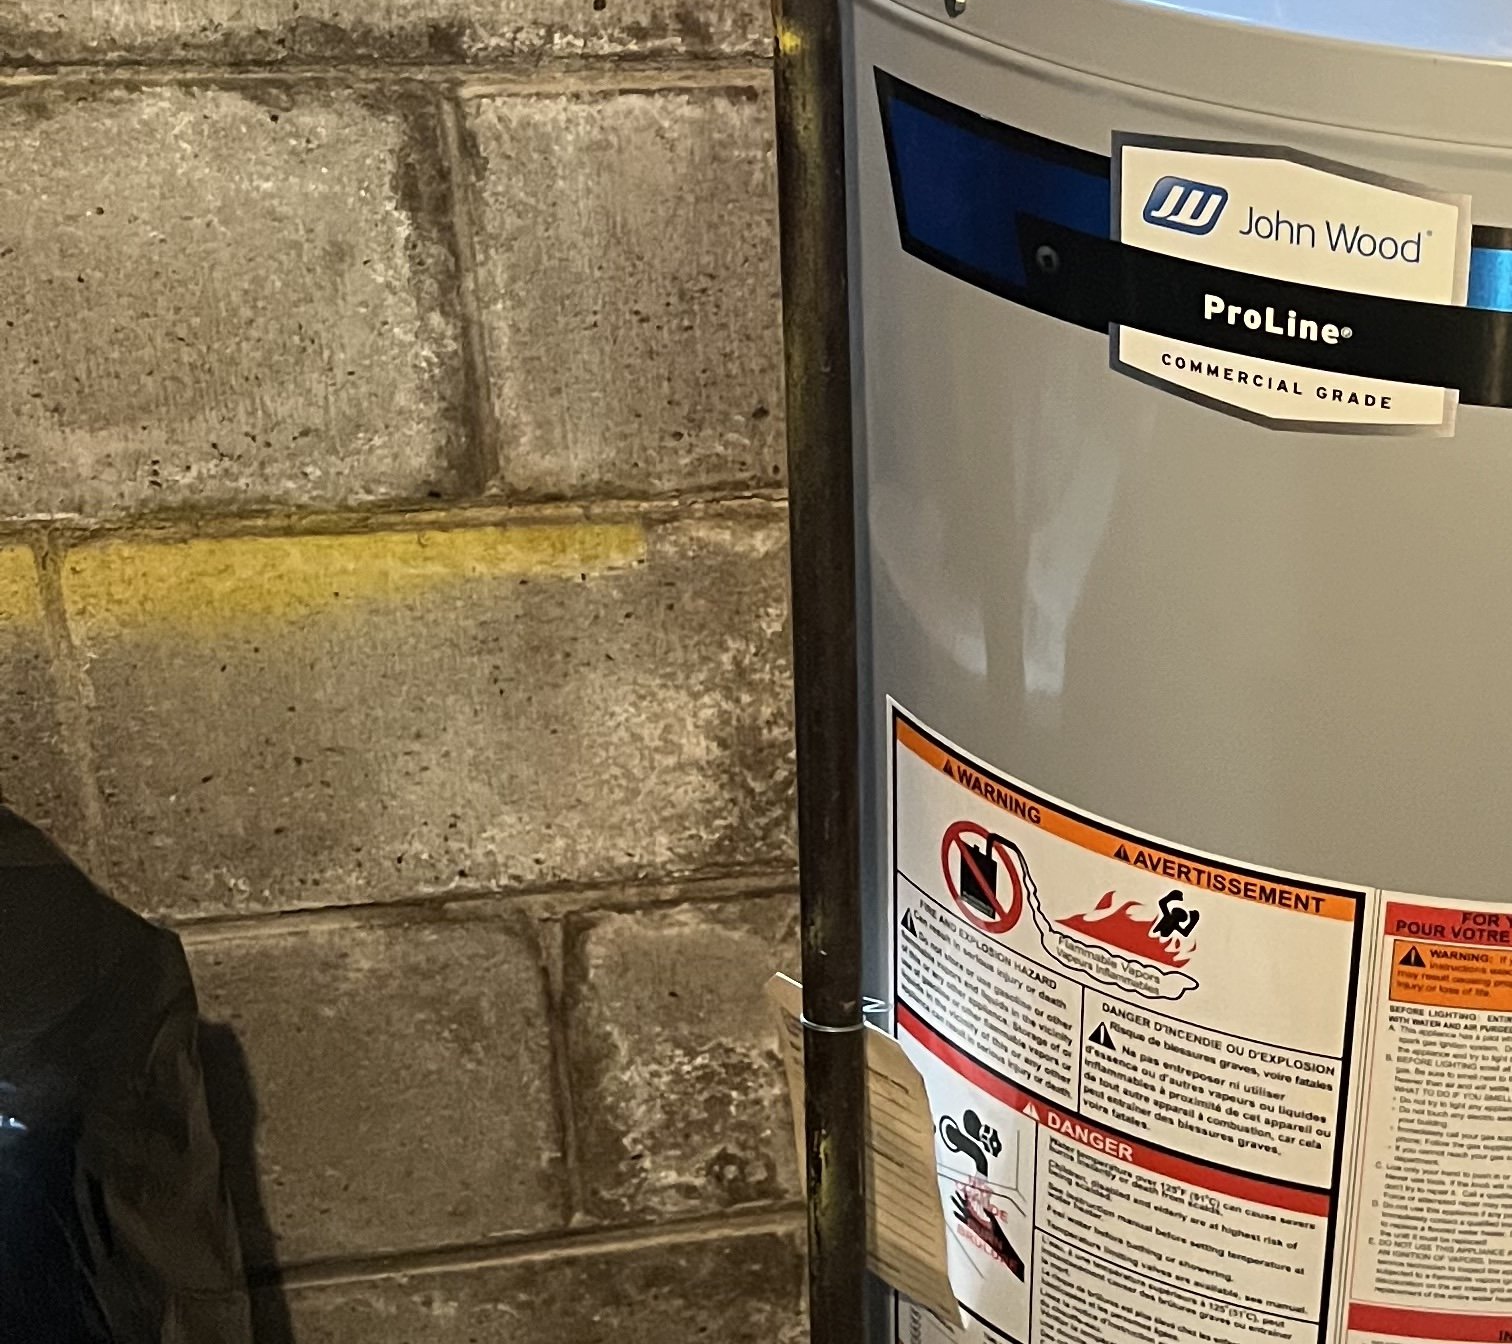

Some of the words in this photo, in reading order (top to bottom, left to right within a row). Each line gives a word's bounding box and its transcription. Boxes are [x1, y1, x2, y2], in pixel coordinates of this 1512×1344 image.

[1239, 206, 1316, 248] John
[1161, 353, 1303, 395] COMMERCIAL
[1316, 386, 1392, 409] GRADE
[956, 765, 1042, 826] WARNING
[1134, 851, 1326, 914] AVERTISSEMENT
[920, 899, 937, 919] FIRE
[939, 916, 956, 932] AND
[959, 929, 1012, 966] EXPLOSION
[1014, 961, 1056, 989] HAZARD
[1395, 919, 1446, 938] POUR
[1452, 927, 1510, 943] VOTRE
[1461, 911, 1500, 928] FOR
[914, 909, 928, 927] Can
[929, 924, 951, 944] result
[953, 939, 960, 950] in
[963, 948, 994, 972] serious
[997, 967, 1023, 990] injury
[1026, 985, 1035, 994] or
[1039, 989, 1067, 1009] death
[1056, 946, 1093, 971] Vapeurs
[1058, 935, 1117, 969] Flammable
[1121, 962, 1160, 984] Vapors
[966, 968, 974, 977] or
[1035, 1008, 1044, 1016] or
[1047, 1014, 1072, 1031] other
[1038, 1024, 1072, 1046] vicinity
[1102, 1002, 1150, 1028] DANGER
[1154, 1021, 1222, 1050] D'INCENDIE
[1226, 1044, 1245, 1055] OU
[1248, 1049, 1335, 1076] D'EXPLOSION
[1110, 1021, 1146, 1042] Risque
[1148, 1037, 1161, 1046] de
[1164, 1040, 1216, 1064] blessures
[1219, 1059, 1260, 1077] graves,
[1263, 1071, 1292, 1082] voire
[1295, 1076, 1333, 1091] fatales
[1085, 1045, 1138, 1072] d'essence
[1141, 1068, 1156, 1079] ou
[1159, 1074, 1205, 1094] d'autres
[1208, 1089, 1255, 1108] vapeurs
[1259, 1103, 1275, 1113] ou
[1279, 1105, 1327, 1123] liquides
[1122, 1045, 1136, 1057] Ne
[1140, 1054, 1160, 1066] pas
[1163, 1062, 1225, 1086] entreposer
[1229, 1081, 1240, 1090] ni
[1243, 1085, 1286, 1100] utiliser
[1083, 1098, 1108, 1114] voire
[1084, 1072, 1096, 1082] de
[1100, 1077, 1120, 1093] tout
[1123, 1088, 1150, 1103] autre
[1153, 1099, 1195, 1118] appareil
[1198, 1112, 1204, 1121] à
[1207, 1116, 1274, 1141] combustion,
[1278, 1134, 1296, 1144] car
[1299, 1138, 1322, 1150] cela
[1084, 1085, 1104, 1099] peut
[1154, 1113, 1174, 1125] des
[1178, 1118, 1234, 1143] blessures
[1160, 1086, 1166, 1095] à
[1168, 1091, 1222, 1112] proximité
[1225, 1107, 1239, 1117] de
[1243, 1112, 1261, 1123] cet
[1264, 1117, 1313, 1134] appareil
[1316, 1129, 1331, 1138] ou
[1047, 1112, 1134, 1162] DANGER
[1190, 1217, 1206, 1226] are
[1264, 1237, 1283, 1246] risk
[1223, 1203, 1242, 1213] can
[1245, 1209, 1276, 1221] cause
